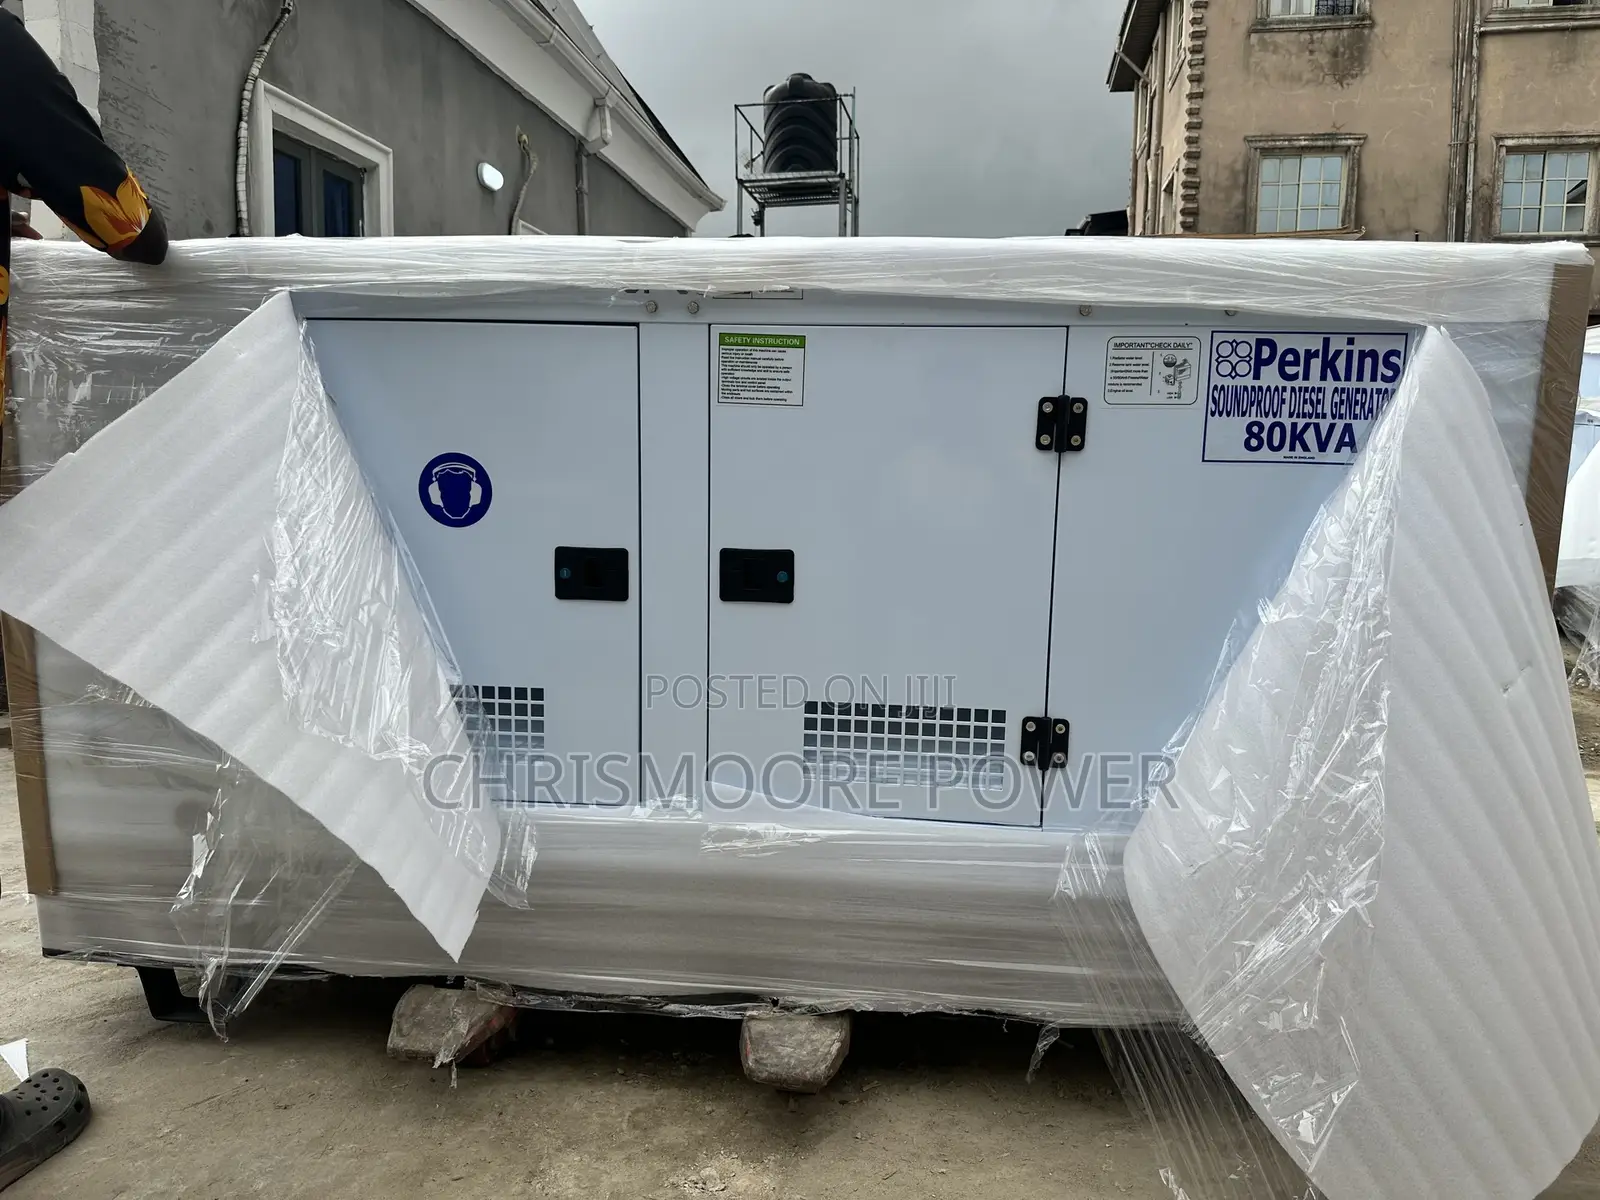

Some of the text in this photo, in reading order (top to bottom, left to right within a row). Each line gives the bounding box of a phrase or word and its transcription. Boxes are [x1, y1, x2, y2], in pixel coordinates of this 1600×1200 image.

[1252, 337, 1401, 383] Perkins
[1210, 384, 1287, 418] SOUNDPROOF
[1288, 386, 1327, 420] DIESEL
[1243, 421, 1358, 454] 80KVA
